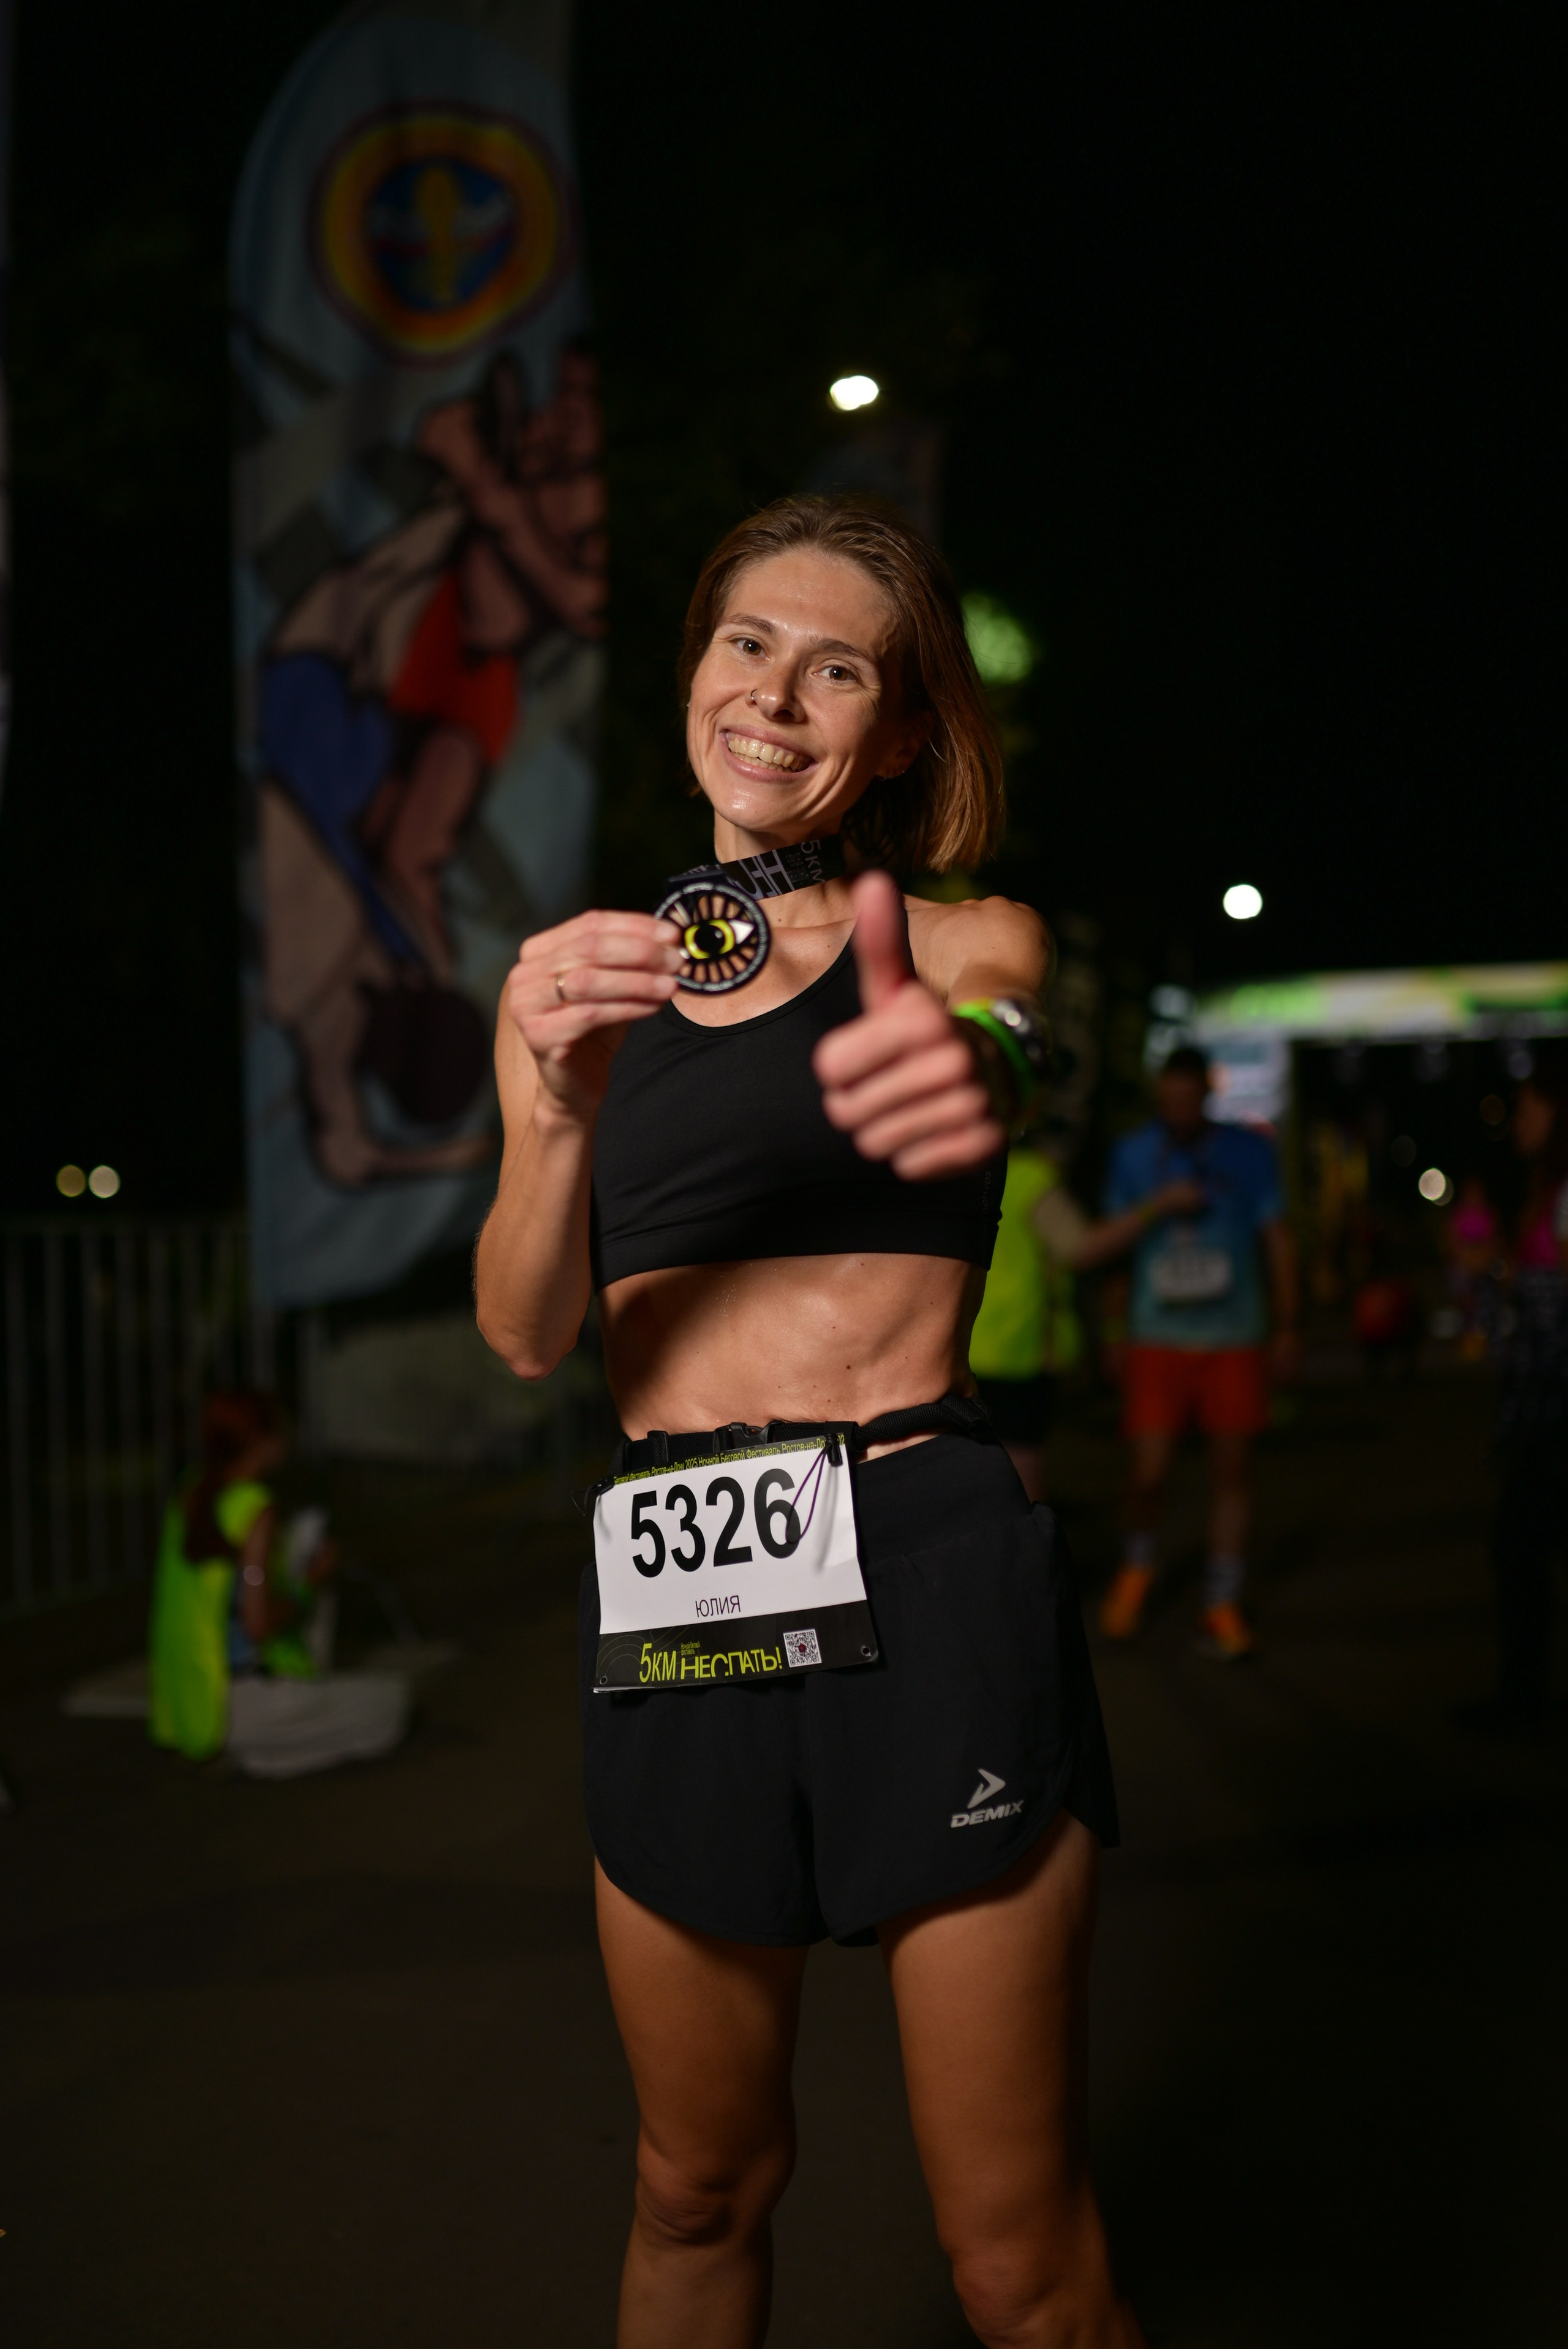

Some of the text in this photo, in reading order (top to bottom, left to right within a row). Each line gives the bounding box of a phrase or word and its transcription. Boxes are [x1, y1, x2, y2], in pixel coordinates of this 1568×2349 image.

[651, 1462, 684, 1477] Ростов-на-Дону
[685, 1458, 698, 1469] 2025
[698, 1454, 720, 1467] Ночной
[720, 1450, 745, 1464] Беговой
[746, 1447, 780, 1459] Фестиваль
[631, 1468, 801, 1578] 5326
[695, 1595, 741, 1617] ЮЛИЯ
[950, 1799, 1024, 1828] DEMIX
